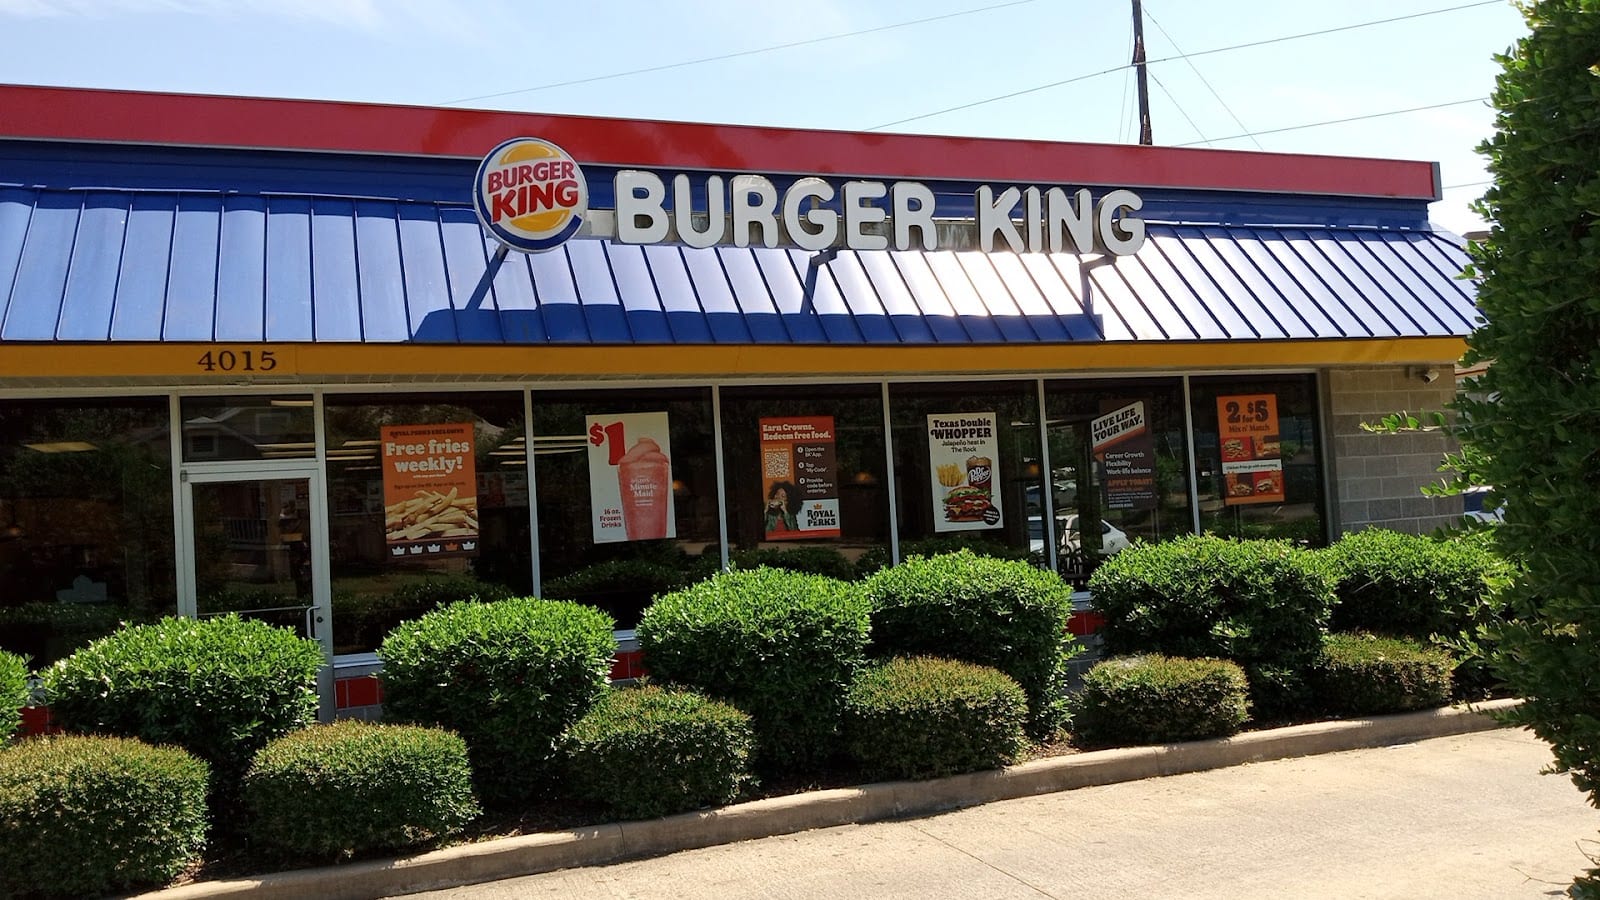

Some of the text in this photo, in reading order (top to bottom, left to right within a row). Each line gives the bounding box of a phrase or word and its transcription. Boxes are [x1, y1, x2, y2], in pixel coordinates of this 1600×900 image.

[488, 161, 575, 194] BURGER
[492, 180, 579, 223] KING
[614, 170, 1147, 256] BURGER KING
[197, 350, 277, 371] 4015
[1225, 400, 1269, 424] 2 for $5
[933, 418, 991, 428] Texas Double
[1093, 407, 1136, 433] LIVE LIFE
[762, 423, 815, 432] Earn Crowns.
[930, 427, 992, 440] WHOPPER
[1094, 414, 1143, 442] YOUR WAY.
[1228, 425, 1242, 433] Mix
[1249, 423, 1270, 432] Match
[763, 430, 832, 441] Redeem free food.
[385, 438, 470, 457] Free fries
[589, 421, 626, 465] $1
[1124, 450, 1145, 458] Growth
[394, 456, 463, 474] weekly!
[975, 466, 985, 475] Dr
[1105, 460, 1131, 468] Flexibility
[970, 468, 990, 483] Pepper
[630, 483, 657, 491] Minute
[807, 509, 836, 521] ROYAL
[808, 518, 836, 527] PERKS
